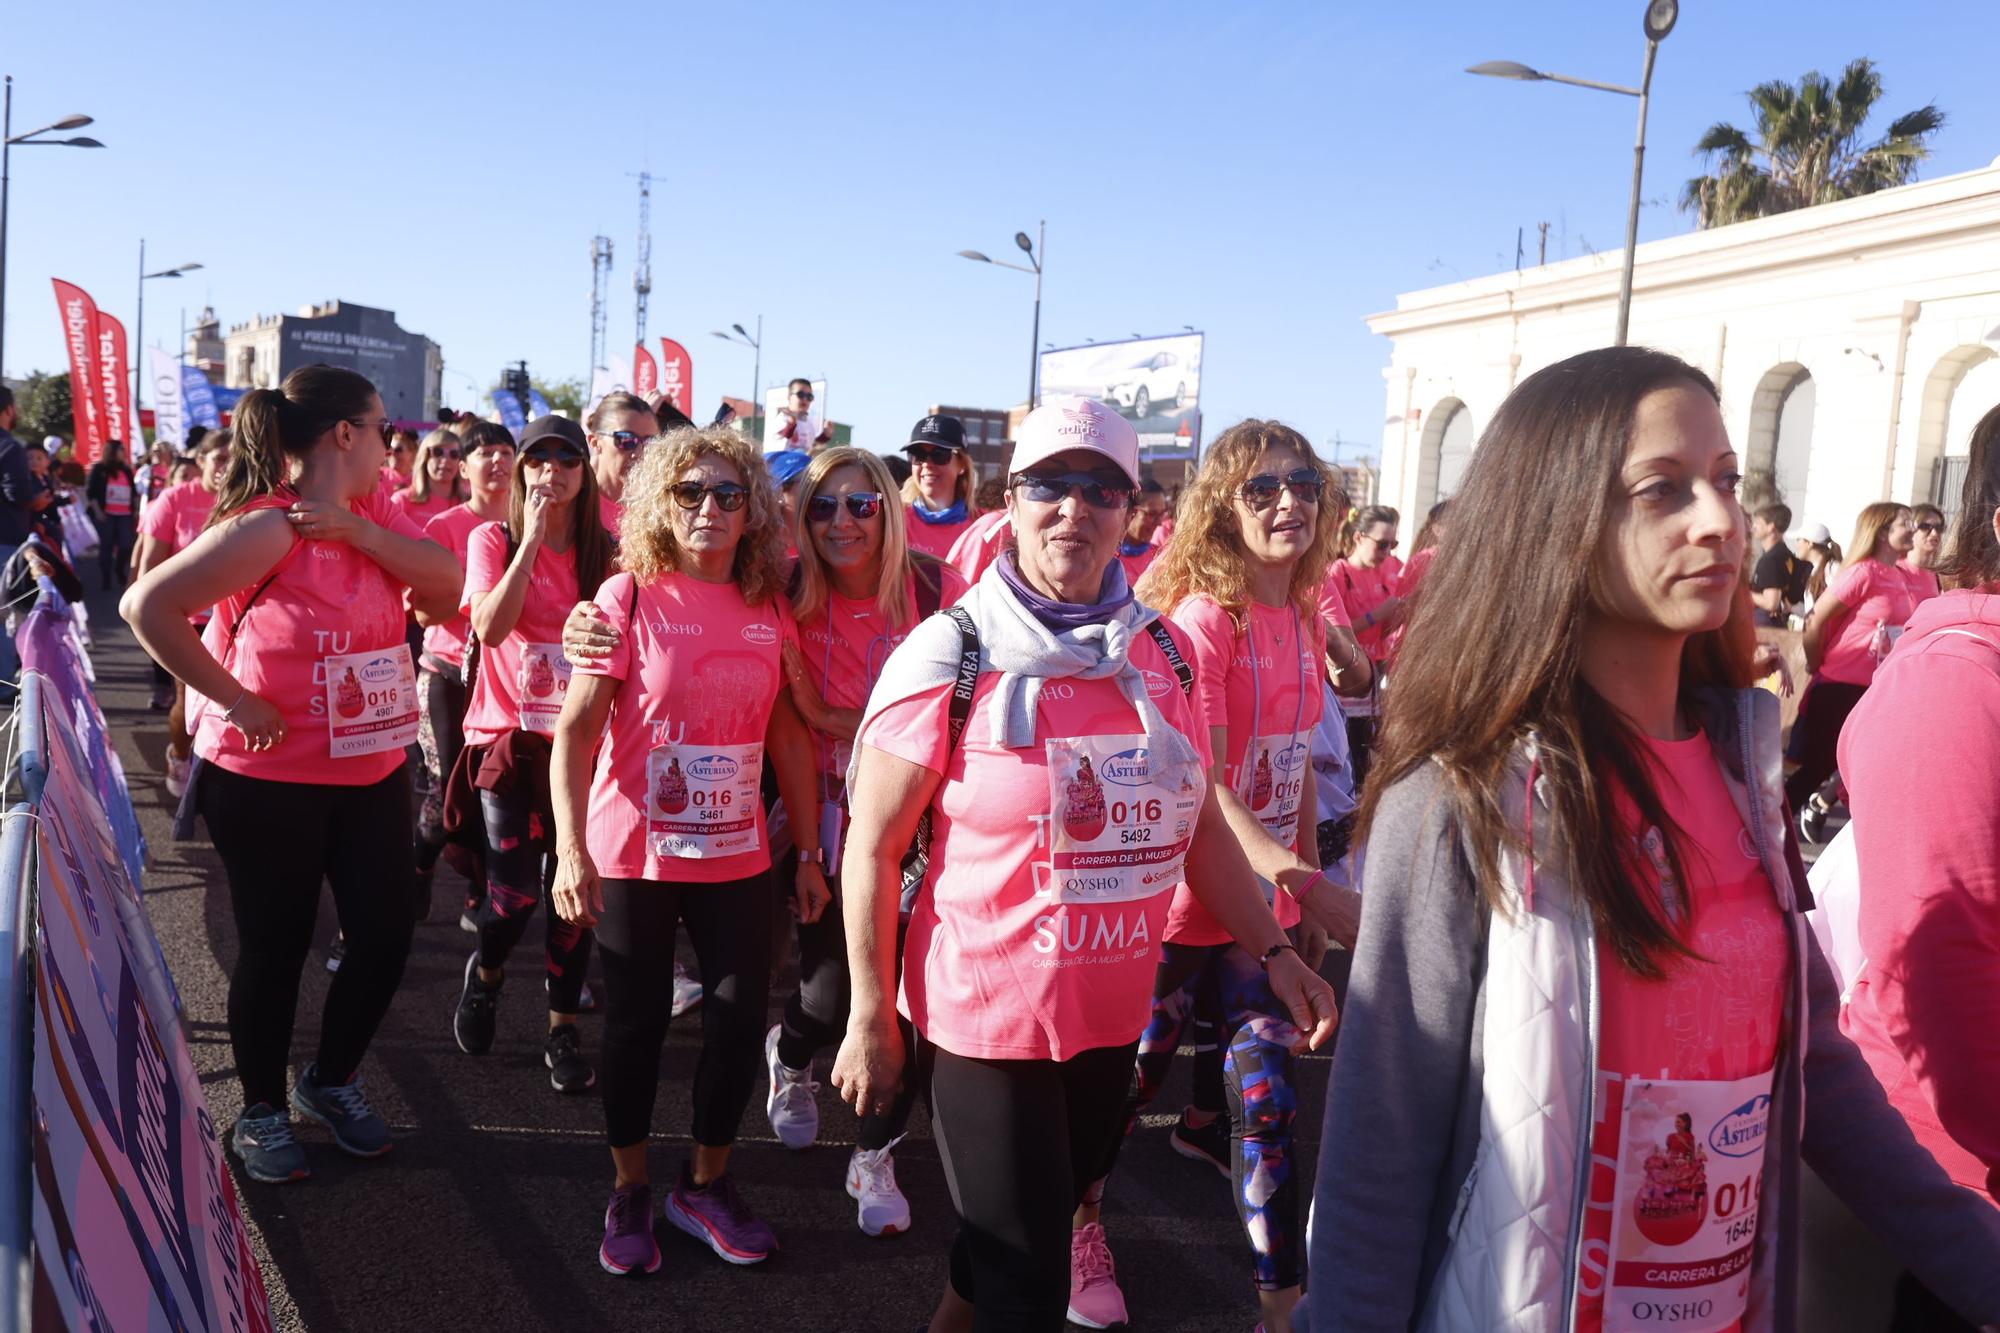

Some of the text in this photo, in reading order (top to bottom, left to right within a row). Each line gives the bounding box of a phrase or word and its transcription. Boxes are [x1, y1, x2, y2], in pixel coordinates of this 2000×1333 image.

[651, 623, 703, 636] OYSHO
[313, 631, 350, 653] TU
[955, 651, 979, 700] BIMBA
[368, 688, 397, 706] 016
[375, 706, 395, 718] 4907
[342, 737, 377, 751] OYSHO
[690, 763, 736, 775] ASTURIANA
[1275, 779, 1300, 798] 016
[692, 790, 732, 806] 016
[700, 809, 724, 820] 5461
[1111, 799, 1162, 824] 016
[663, 824, 697, 832] CARRERA
[719, 823, 739, 831] MUJER
[1121, 828, 1151, 844] 5492
[660, 838, 697, 849] OYSHO
[1072, 855, 1117, 866] CARRERA
[1119, 854, 1134, 863] DE
[1135, 853, 1144, 861] LA
[1145, 849, 1172, 861] MUJER
[1066, 876, 1119, 893] OYSHO
[1032, 909, 1150, 954] SUMA
[1645, 1261, 1716, 1283] CARRERA
[1718, 1258, 1733, 1275] DE
[1632, 1299, 1713, 1322] OYSHO
